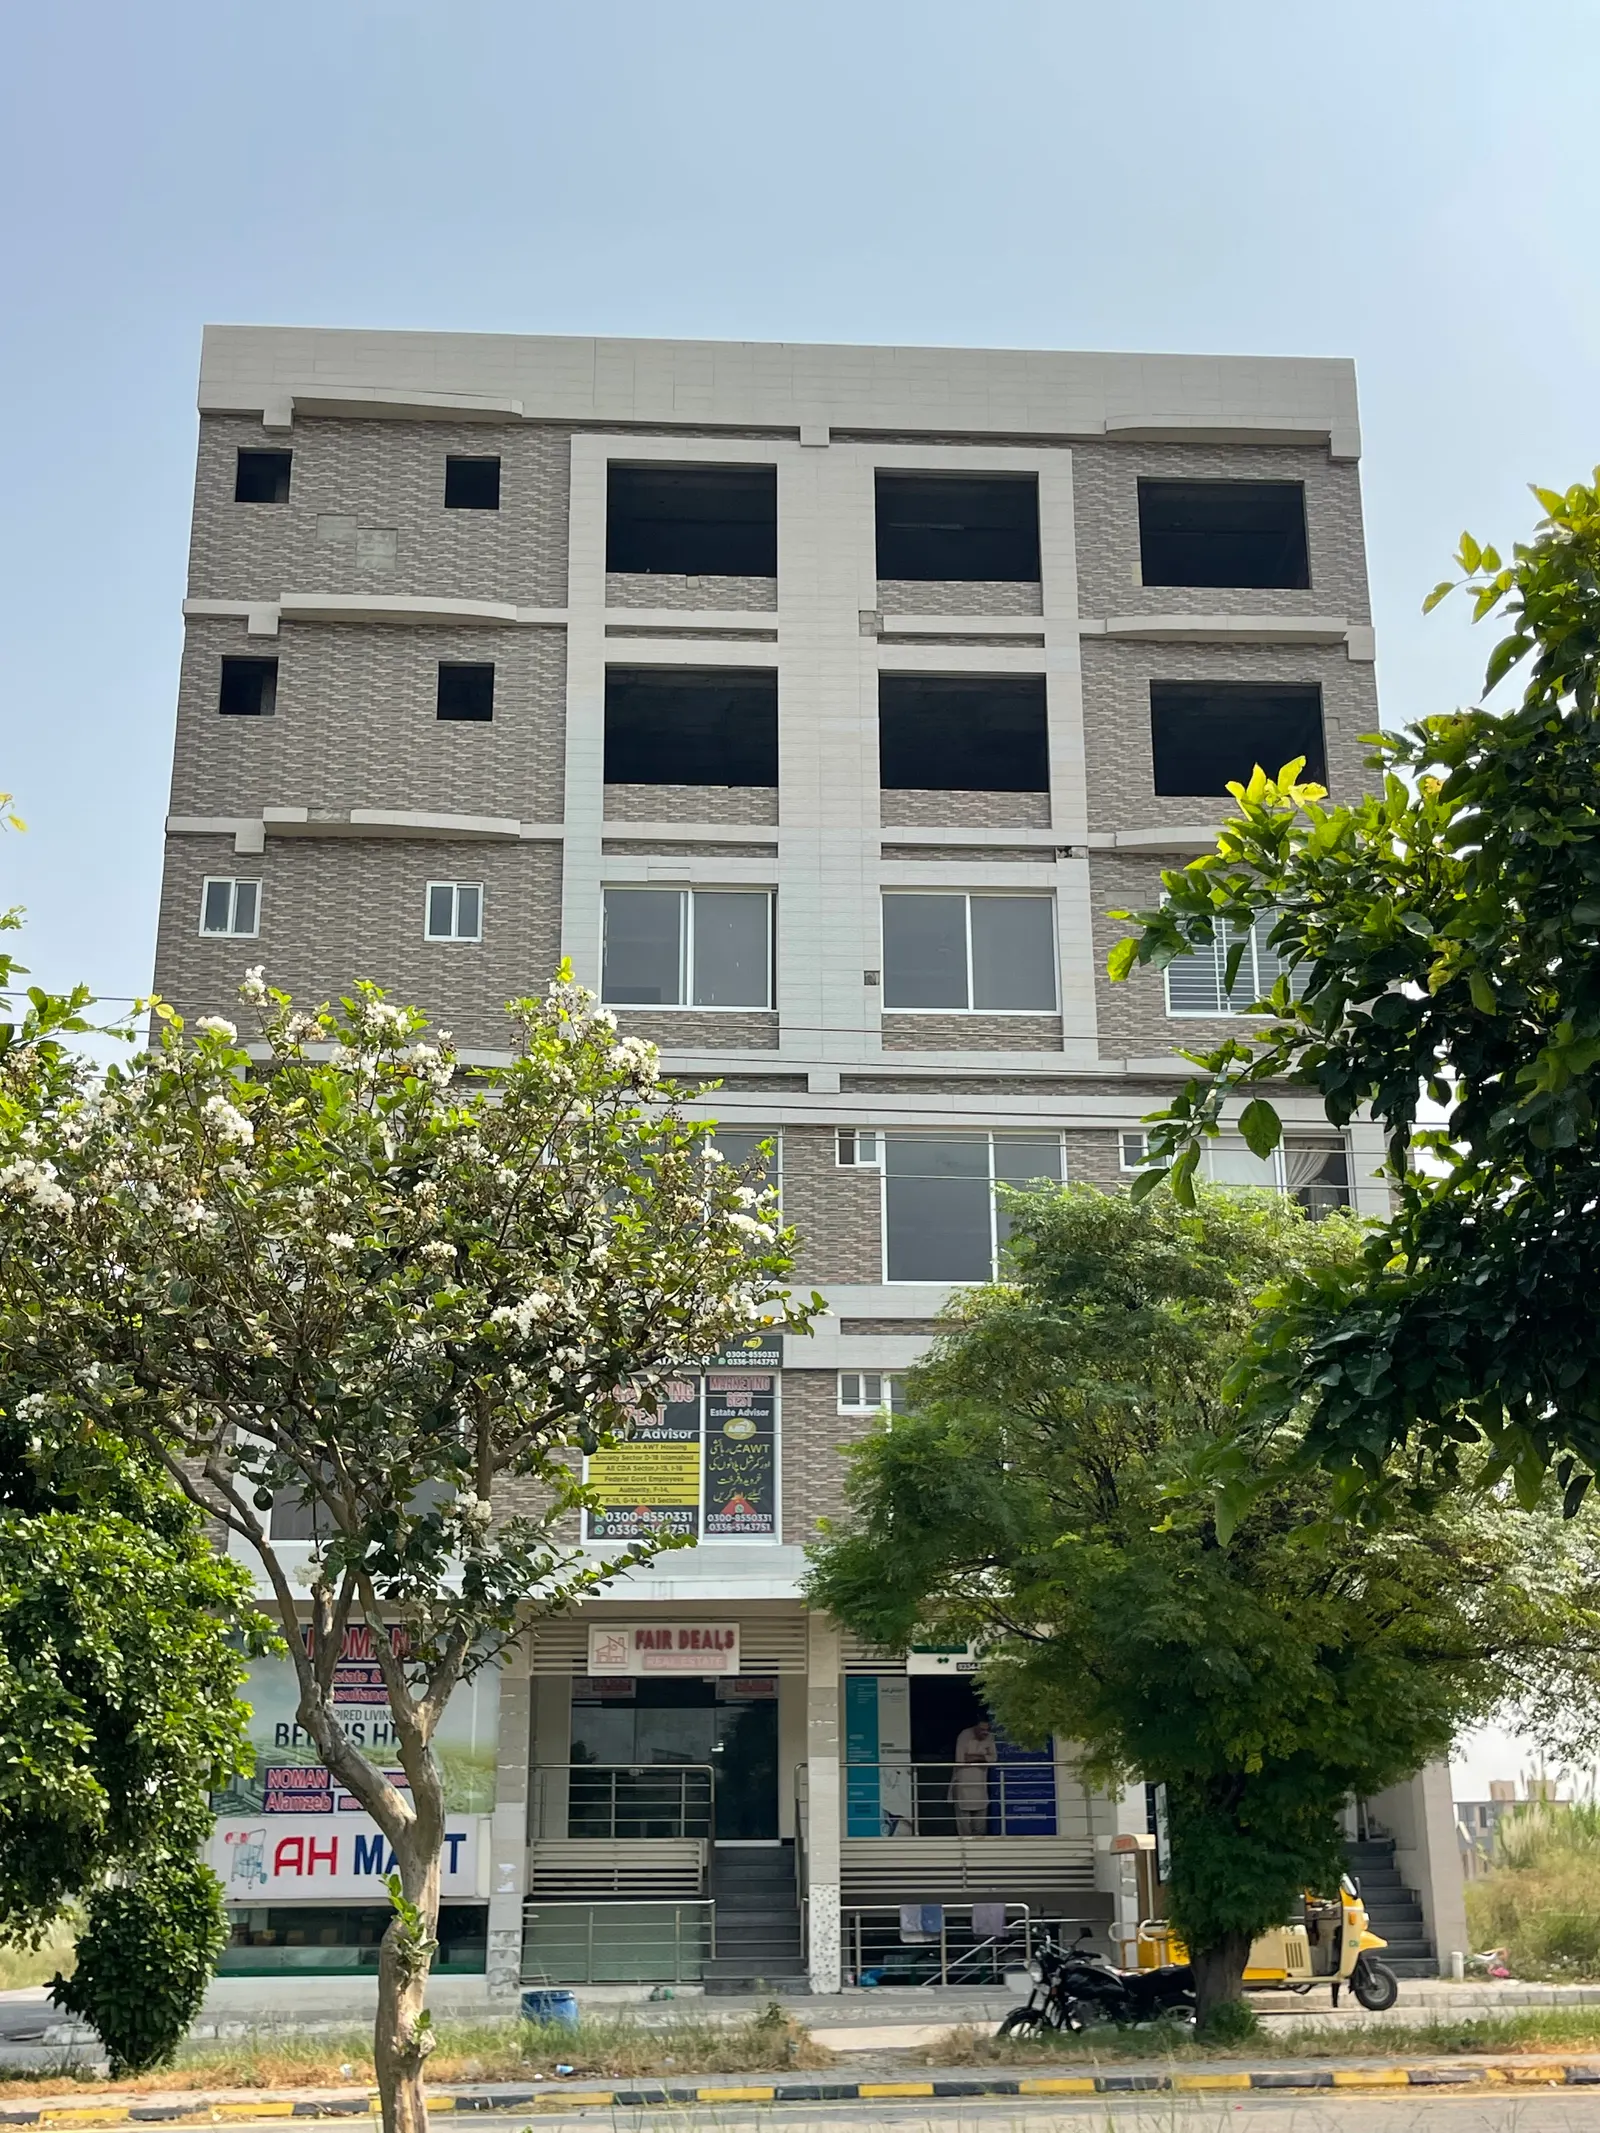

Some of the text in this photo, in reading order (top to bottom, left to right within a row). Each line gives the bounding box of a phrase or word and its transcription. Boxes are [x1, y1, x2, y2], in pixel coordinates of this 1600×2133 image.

[709, 1376, 771, 1391] MARKETING
[726, 1392, 754, 1407] BEST
[710, 1409, 770, 1417] Estate Advisor
[641, 1428, 693, 1439] Advisor
[742, 1444, 771, 1453] AWT
[605, 1511, 693, 1522] 0300-8550331
[707, 1514, 772, 1522] 0300-8550331
[708, 1523, 771, 1531] 0336-5143751
[635, 1629, 735, 1651] FAIR DEALS
[681, 1656, 724, 1667] ESTATE
[333, 1670, 368, 1683] state
[267, 1768, 329, 1789] NOMAN
[265, 1791, 332, 1812] Alamzeb
[273, 1833, 467, 1877] AH MAT
